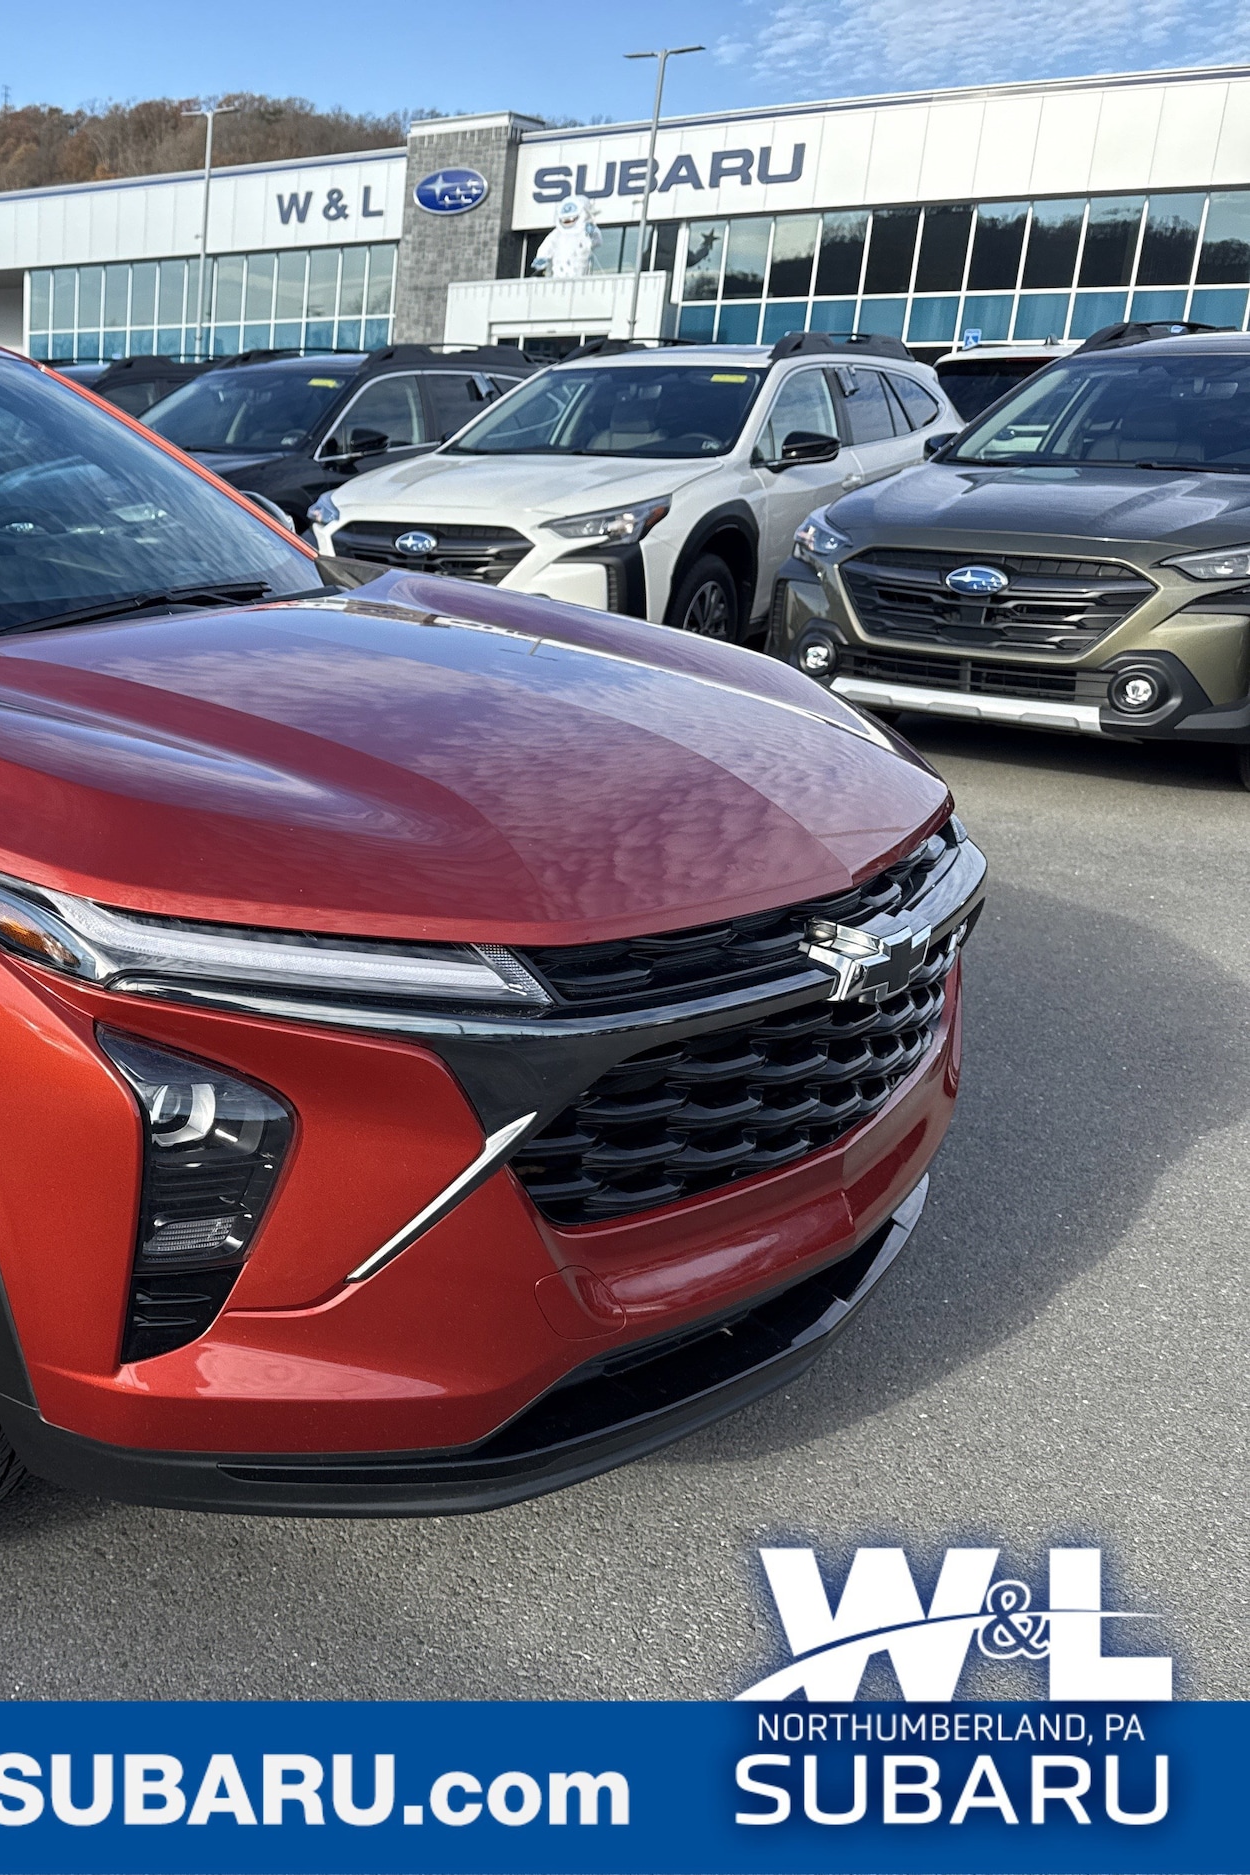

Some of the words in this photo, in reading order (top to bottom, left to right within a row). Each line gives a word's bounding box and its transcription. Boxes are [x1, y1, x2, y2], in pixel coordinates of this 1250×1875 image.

[533, 143, 806, 203] SUBARU
[277, 190, 313, 225] W
[322, 188, 349, 221] &
[362, 185, 384, 218] L
